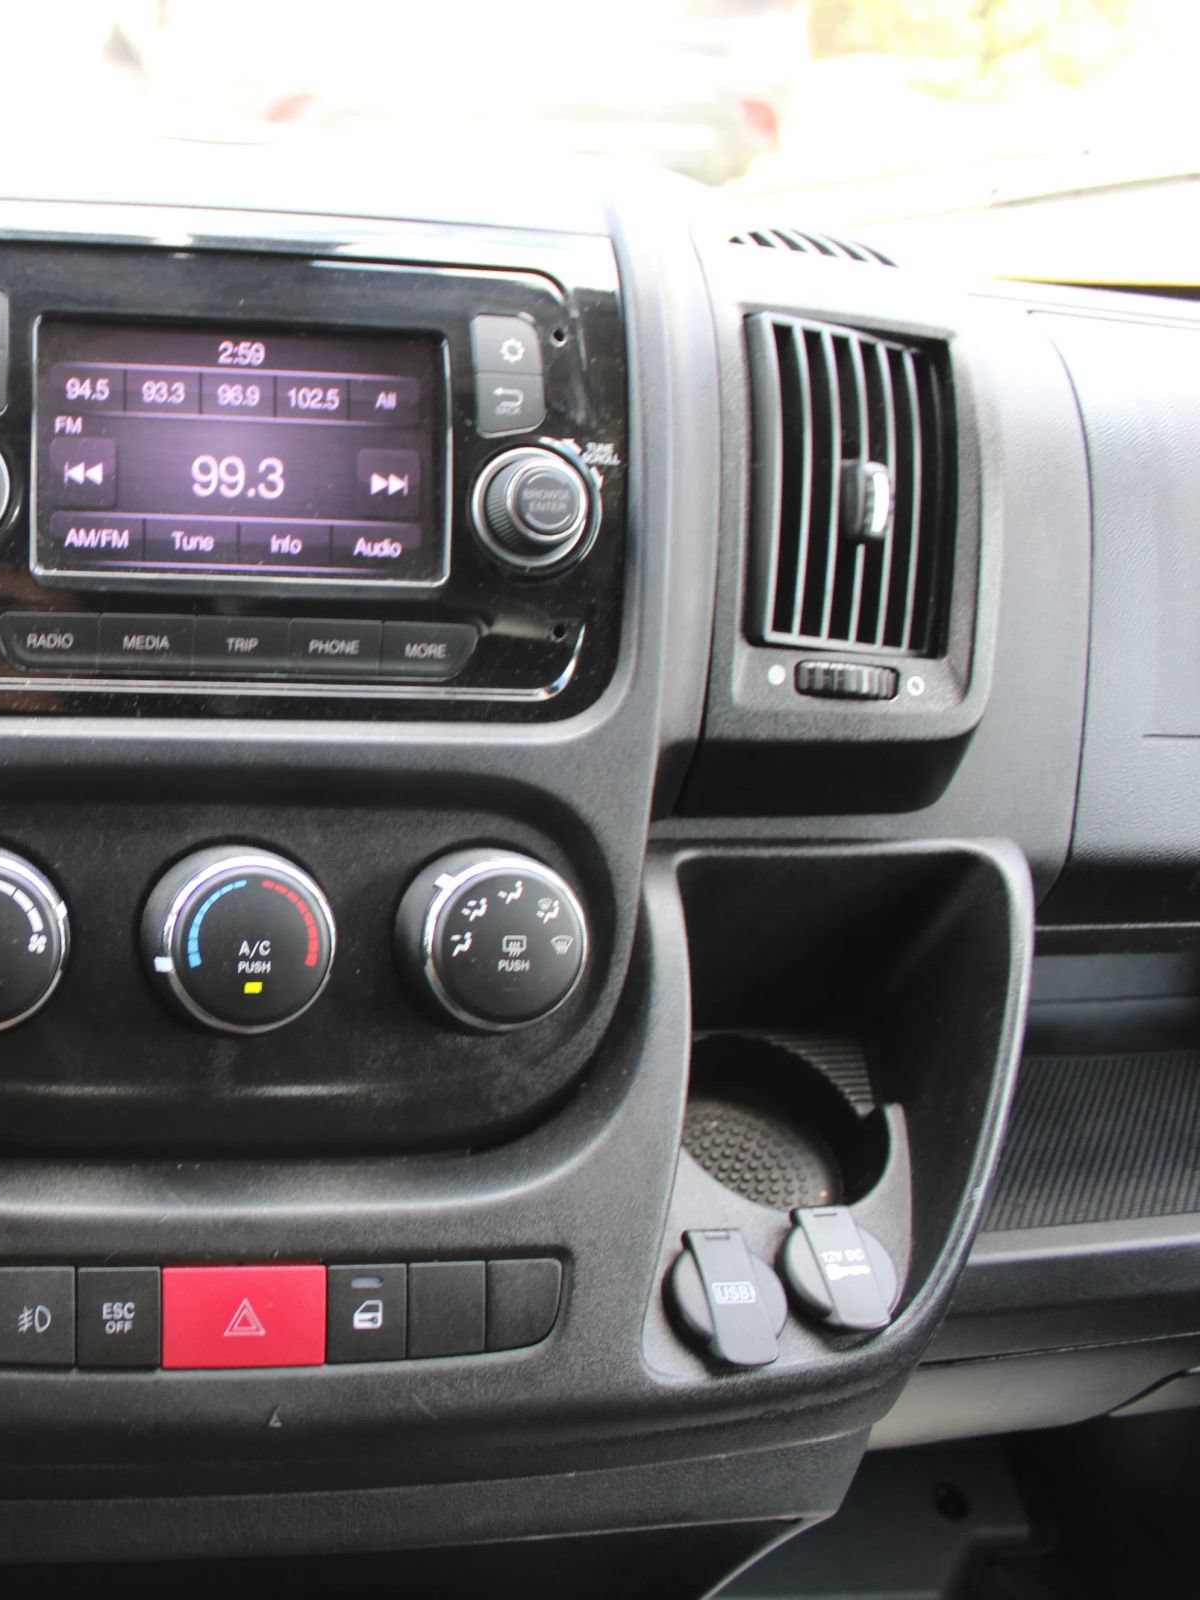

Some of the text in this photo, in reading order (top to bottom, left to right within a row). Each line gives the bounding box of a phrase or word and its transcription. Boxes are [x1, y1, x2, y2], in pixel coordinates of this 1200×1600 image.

[218, 341, 266, 366] 2:59
[66, 377, 110, 400] 94.5
[142, 381, 185, 404] 93.3
[217, 384, 260, 407] 96.9
[288, 387, 340, 411] 102.5
[54, 416, 83, 434] FM
[191, 454, 285, 499] 99.3
[64, 528, 402, 558] AM/FM Tune Info Audio
[26, 633, 447, 658] RADIO MEDIA TRIP PHONE MORE
[238, 940, 272, 957] A/C
[237, 960, 271, 974] PUSH
[497, 959, 530, 972] PUSH
[717, 1284, 750, 1300] USB
[102, 1301, 136, 1320] ESC
[105, 1320, 133, 1334] OFF
